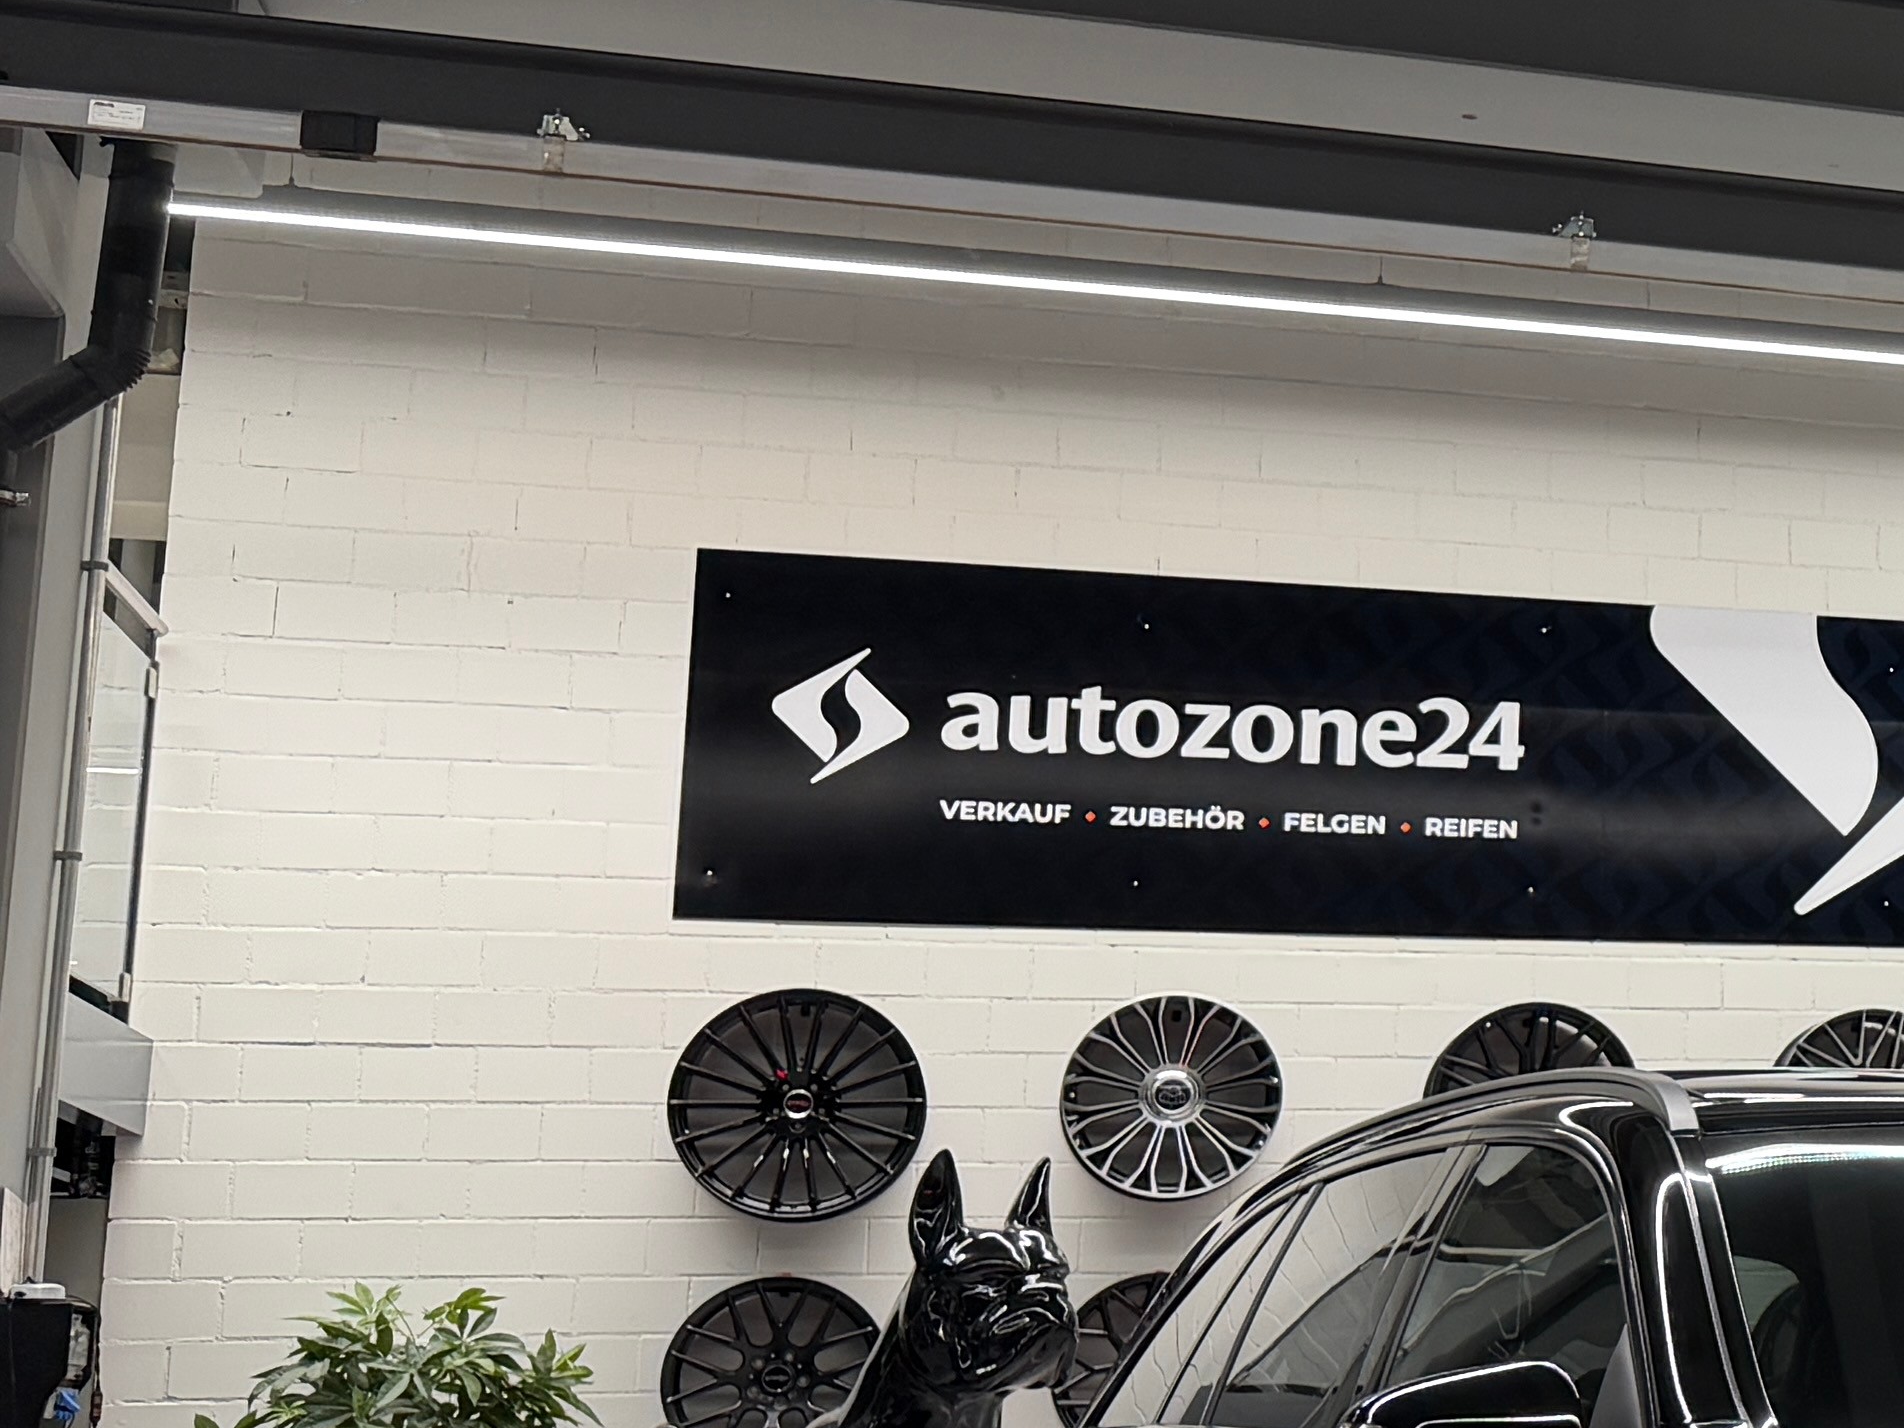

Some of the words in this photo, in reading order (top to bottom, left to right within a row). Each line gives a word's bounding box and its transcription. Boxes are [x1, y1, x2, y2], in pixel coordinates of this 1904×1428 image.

[940, 685, 1526, 771] autozone24
[939, 799, 1072, 824] VERKAUF
[1109, 805, 1245, 831] ZUBEHÖR
[1283, 812, 1386, 835] FELGEN
[1424, 816, 1518, 839] REIFEN
